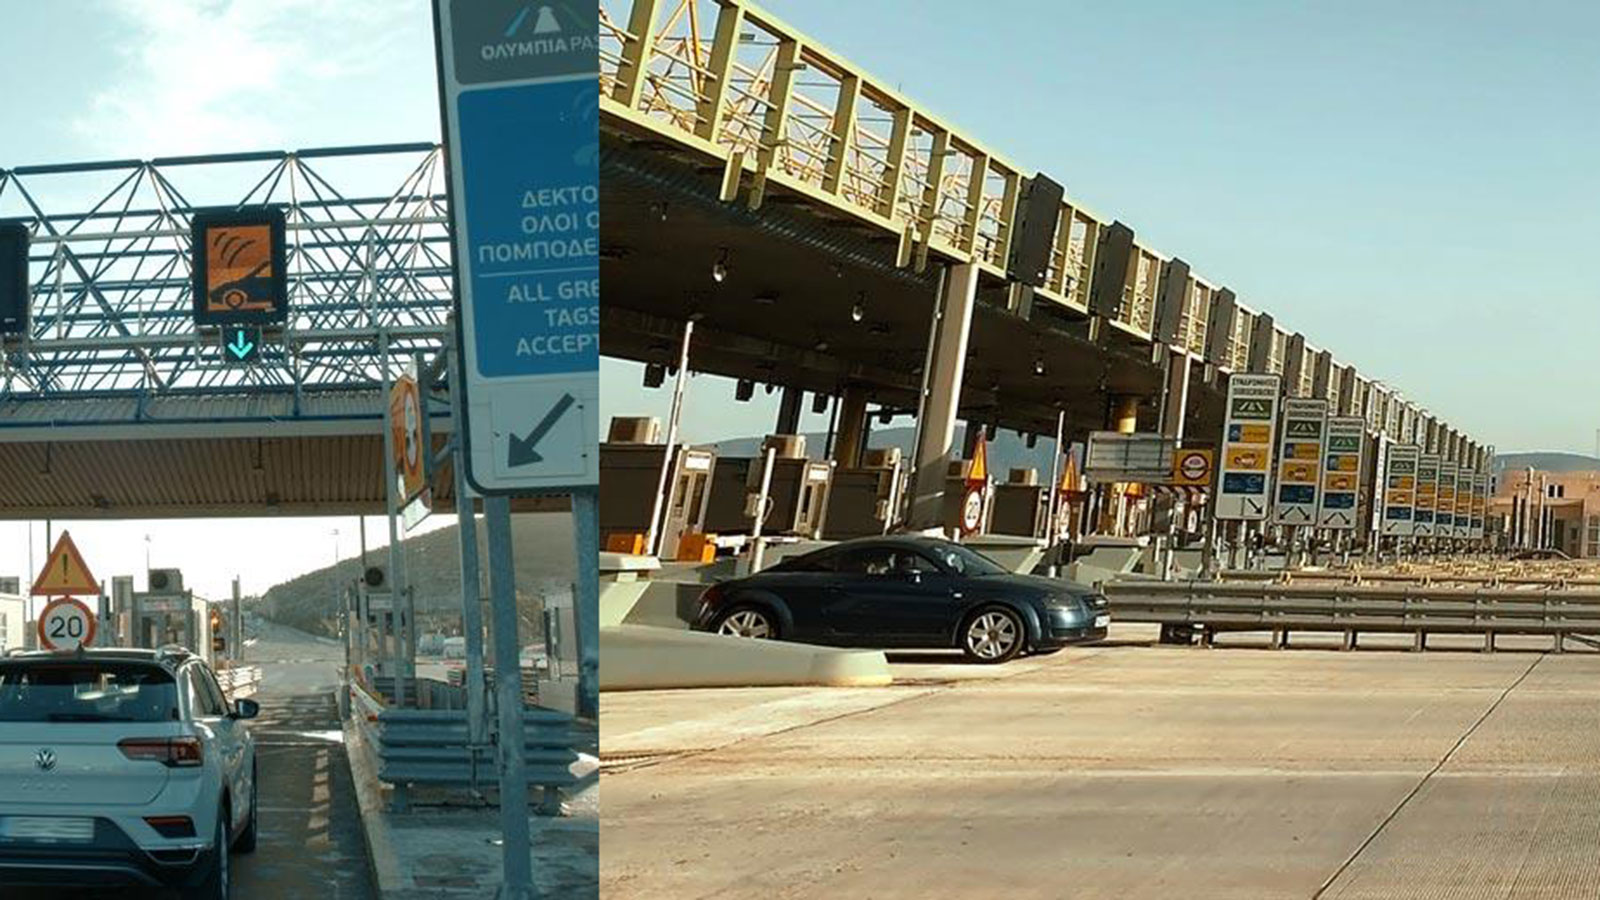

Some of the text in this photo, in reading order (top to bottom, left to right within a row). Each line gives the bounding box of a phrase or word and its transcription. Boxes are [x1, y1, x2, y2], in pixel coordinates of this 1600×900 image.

[481, 38, 568, 60] ΟΛΥΜΠΙΑ
[522, 185, 598, 208] ΔΕΚΤΟ
[521, 212, 578, 234] ΟΛΟΙ
[479, 238, 599, 263] ΠΟΜΠΟΔΕ
[507, 283, 552, 303] ALL
[544, 306, 599, 327] TAGS
[50, 616, 82, 638] 20
